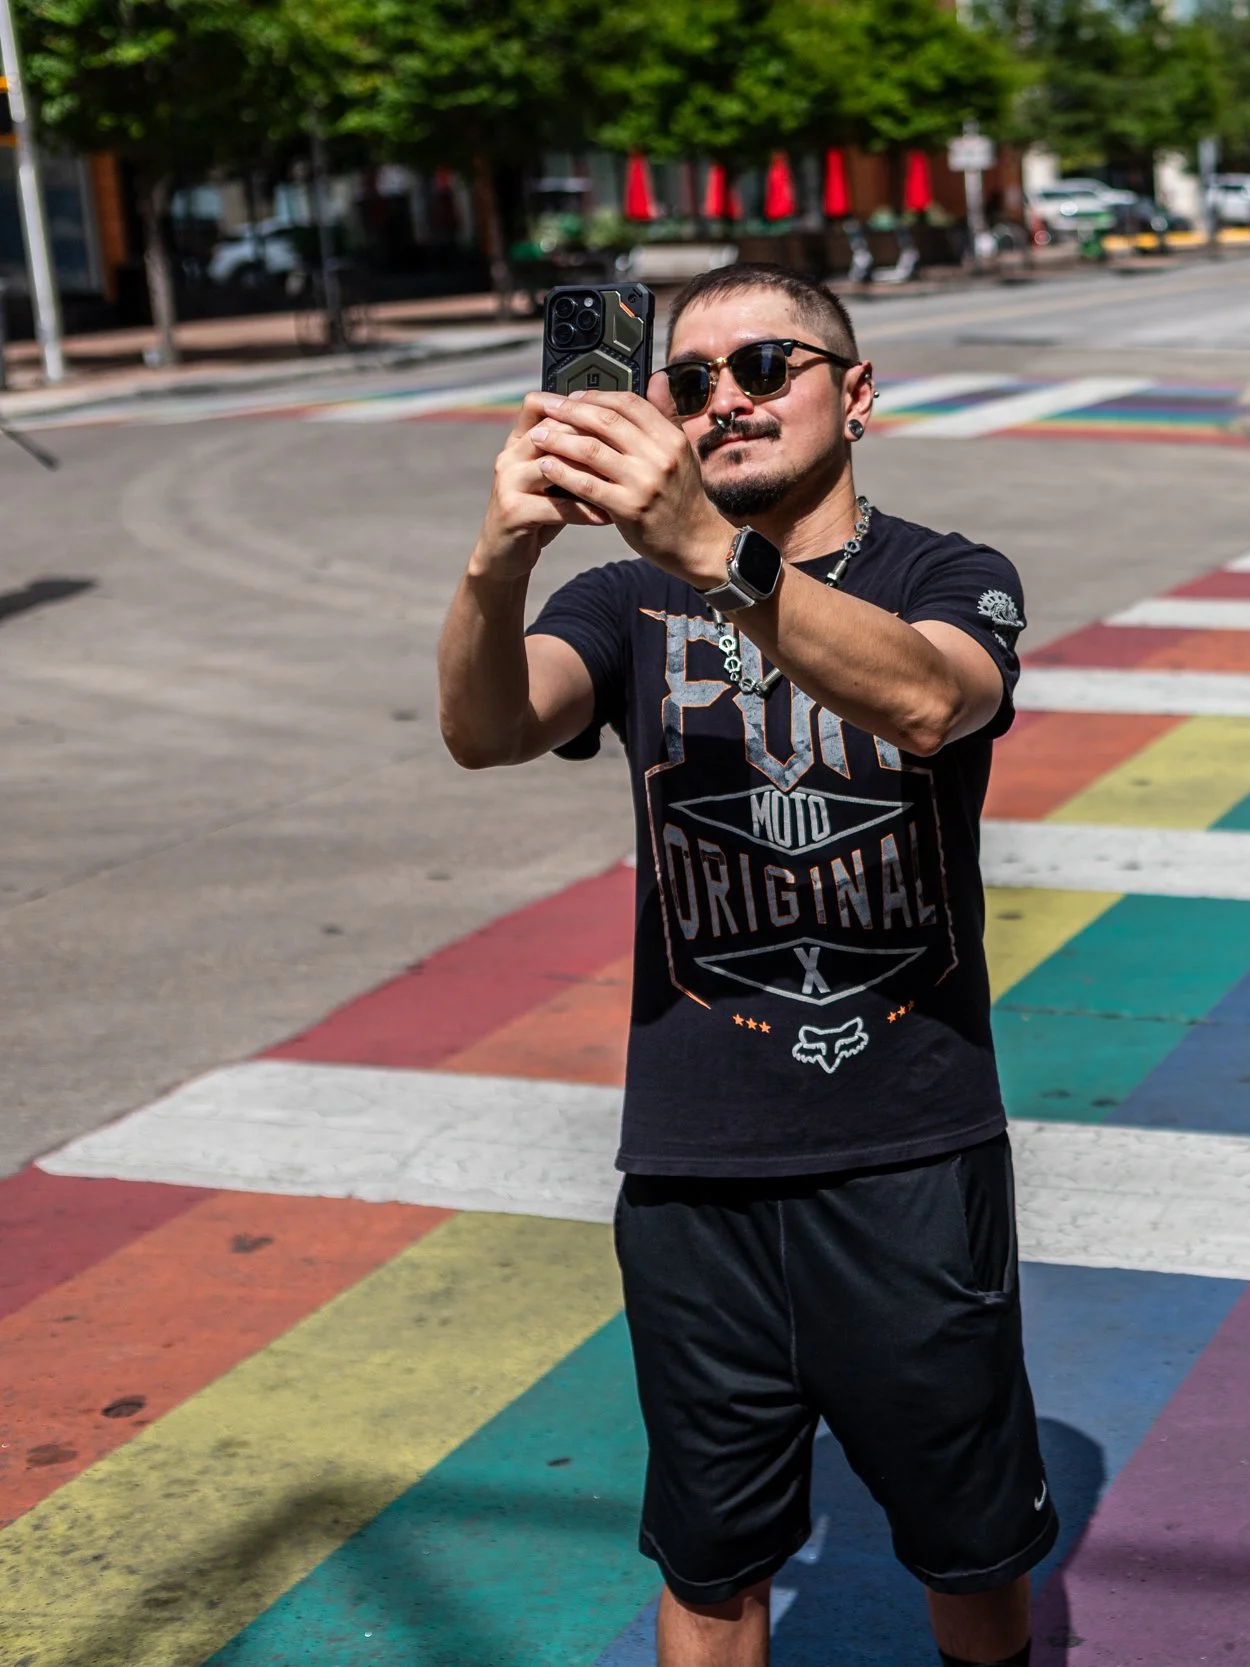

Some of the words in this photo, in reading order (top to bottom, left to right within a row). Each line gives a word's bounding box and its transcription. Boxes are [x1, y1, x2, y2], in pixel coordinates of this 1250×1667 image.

[750, 791, 831, 848] MOTO
[663, 822, 937, 940] ORIGINAL
[793, 946, 831, 994] X
